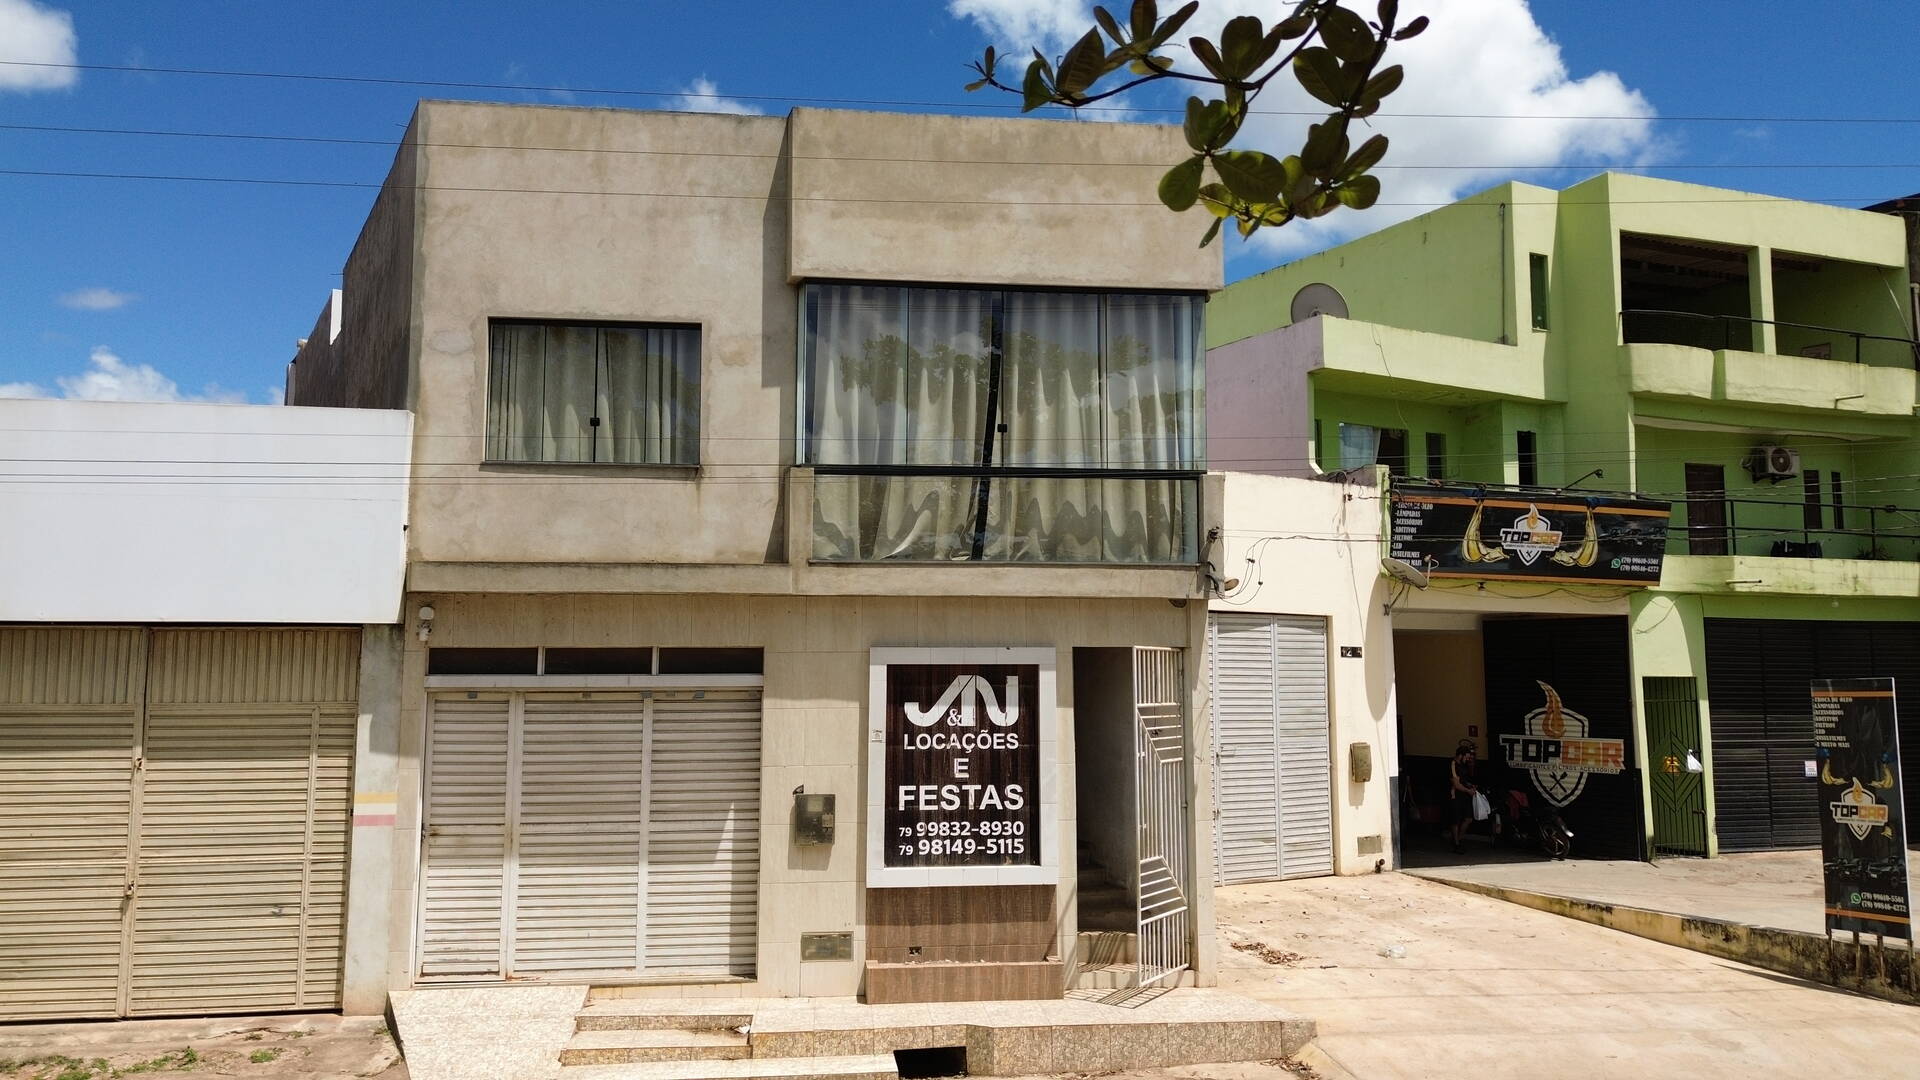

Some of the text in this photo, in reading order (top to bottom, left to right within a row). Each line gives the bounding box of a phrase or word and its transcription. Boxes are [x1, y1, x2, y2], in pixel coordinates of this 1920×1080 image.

[904, 730, 1019, 753] LOCAÇÕES
[1501, 738, 1624, 769] TOPCAR
[954, 758, 970, 778] E
[898, 784, 1024, 811] FESTAS
[1832, 804, 1887, 820] TOPCAR
[899, 821, 1024, 837] 79 99832-8930
[899, 839, 1024, 855] 79 98149-5115
